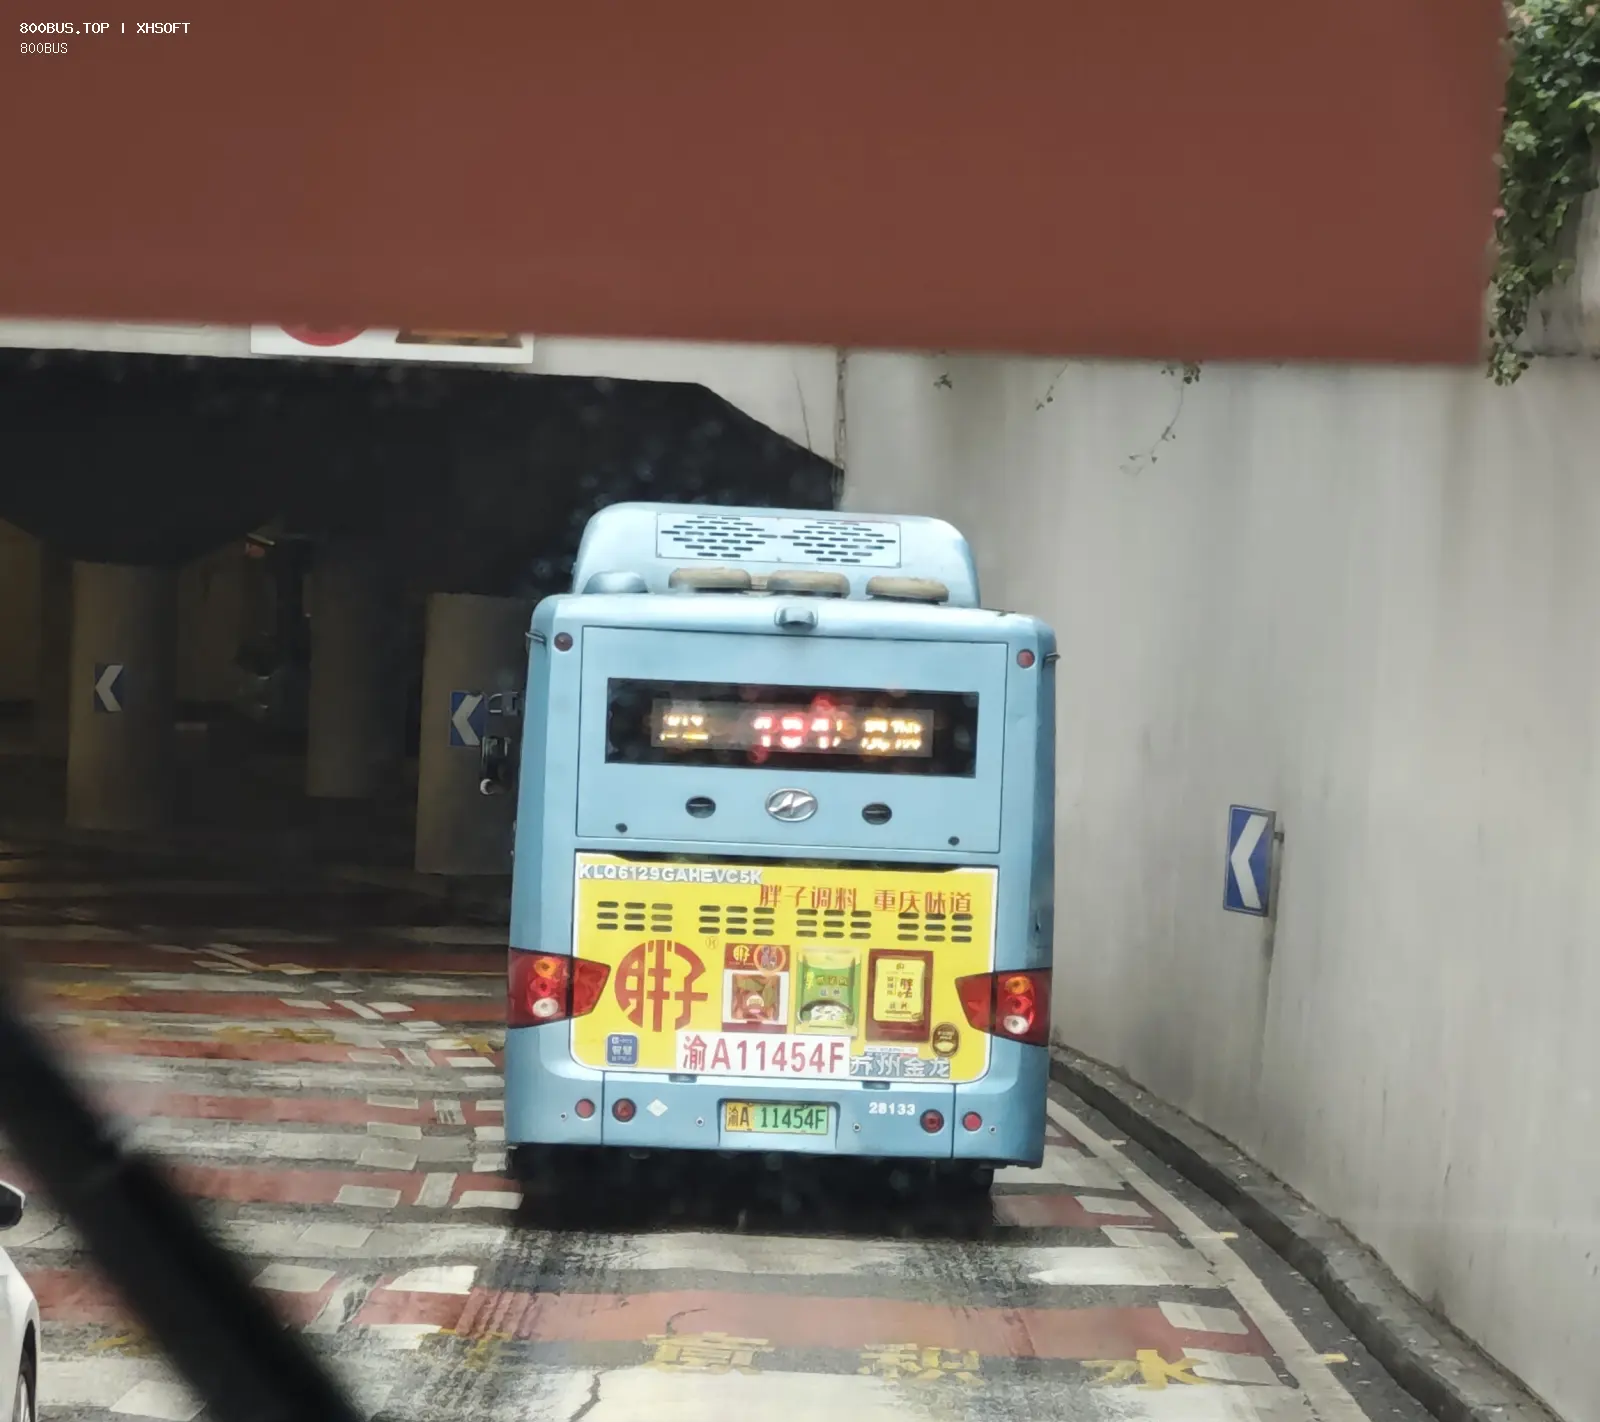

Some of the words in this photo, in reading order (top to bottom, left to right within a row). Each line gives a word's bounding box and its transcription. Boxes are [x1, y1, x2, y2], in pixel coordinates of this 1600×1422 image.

[579, 864, 763, 884] KLQ6129GAHEVC5K
[760, 884, 858, 911] 胖子调料
[874, 889, 972, 914] 重庆味道
[682, 1036, 845, 1074] 渝A11454F
[868, 1102, 915, 1116] 28133
